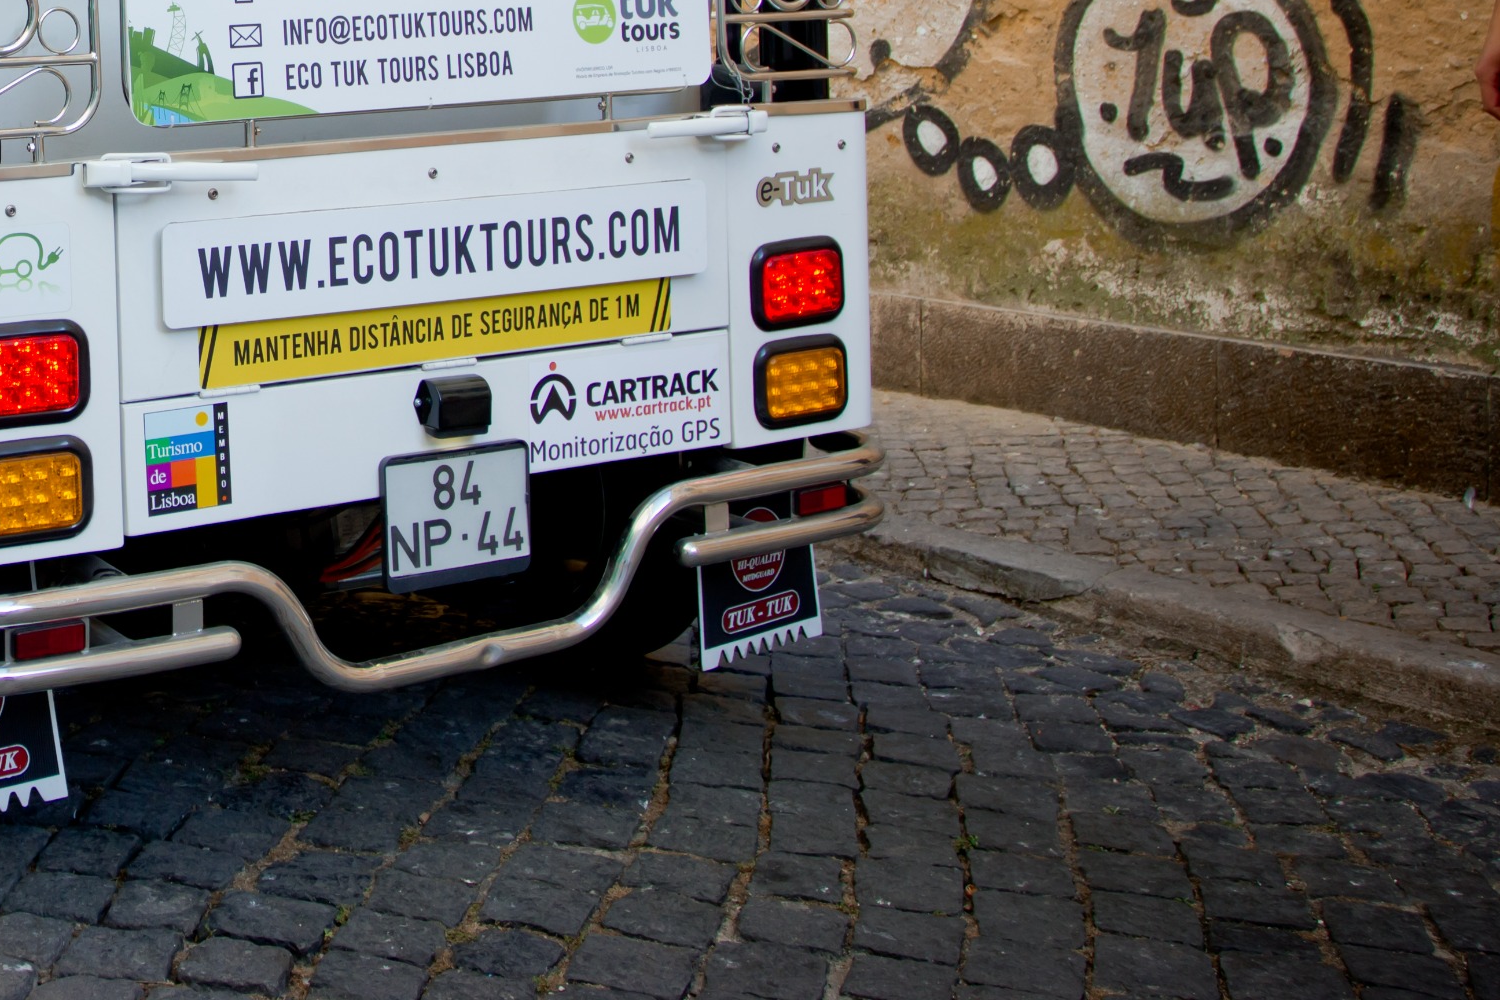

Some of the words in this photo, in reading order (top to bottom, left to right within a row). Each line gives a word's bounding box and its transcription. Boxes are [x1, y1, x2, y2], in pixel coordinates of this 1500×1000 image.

[283, 6, 533, 45] INFO@ECOTUKTOURS.COM
[621, 21, 680, 43] tours
[636, 45, 668, 53] LISBOA
[285, 62, 322, 91] ECO
[330, 59, 369, 87] TUK
[377, 55, 440, 84] TOURS
[447, 50, 513, 80] LISBOA
[759, 171, 830, 204] e-Tuk
[197, 205, 681, 300] WWW.ECOTUKTOURS.COM
[233, 329, 342, 367] MANTENHA
[349, 315, 445, 352] DISTÂNCIA
[451, 312, 473, 339] DE
[480, 301, 583, 335] SEGURANÇA
[589, 297, 610, 322] DE
[586, 368, 719, 407] CARTRACK
[595, 394, 712, 422] www.cartrack.pt
[147, 441, 203, 460] Turismo
[217, 411, 227, 488] MEMBRO
[530, 424, 673, 464] Monitorização
[681, 417, 721, 443] GPS
[150, 469, 167, 485] de
[432, 460, 482, 510] 84
[150, 491, 196, 511] Lisboa
[737, 551, 783, 571] HI-QUALITY
